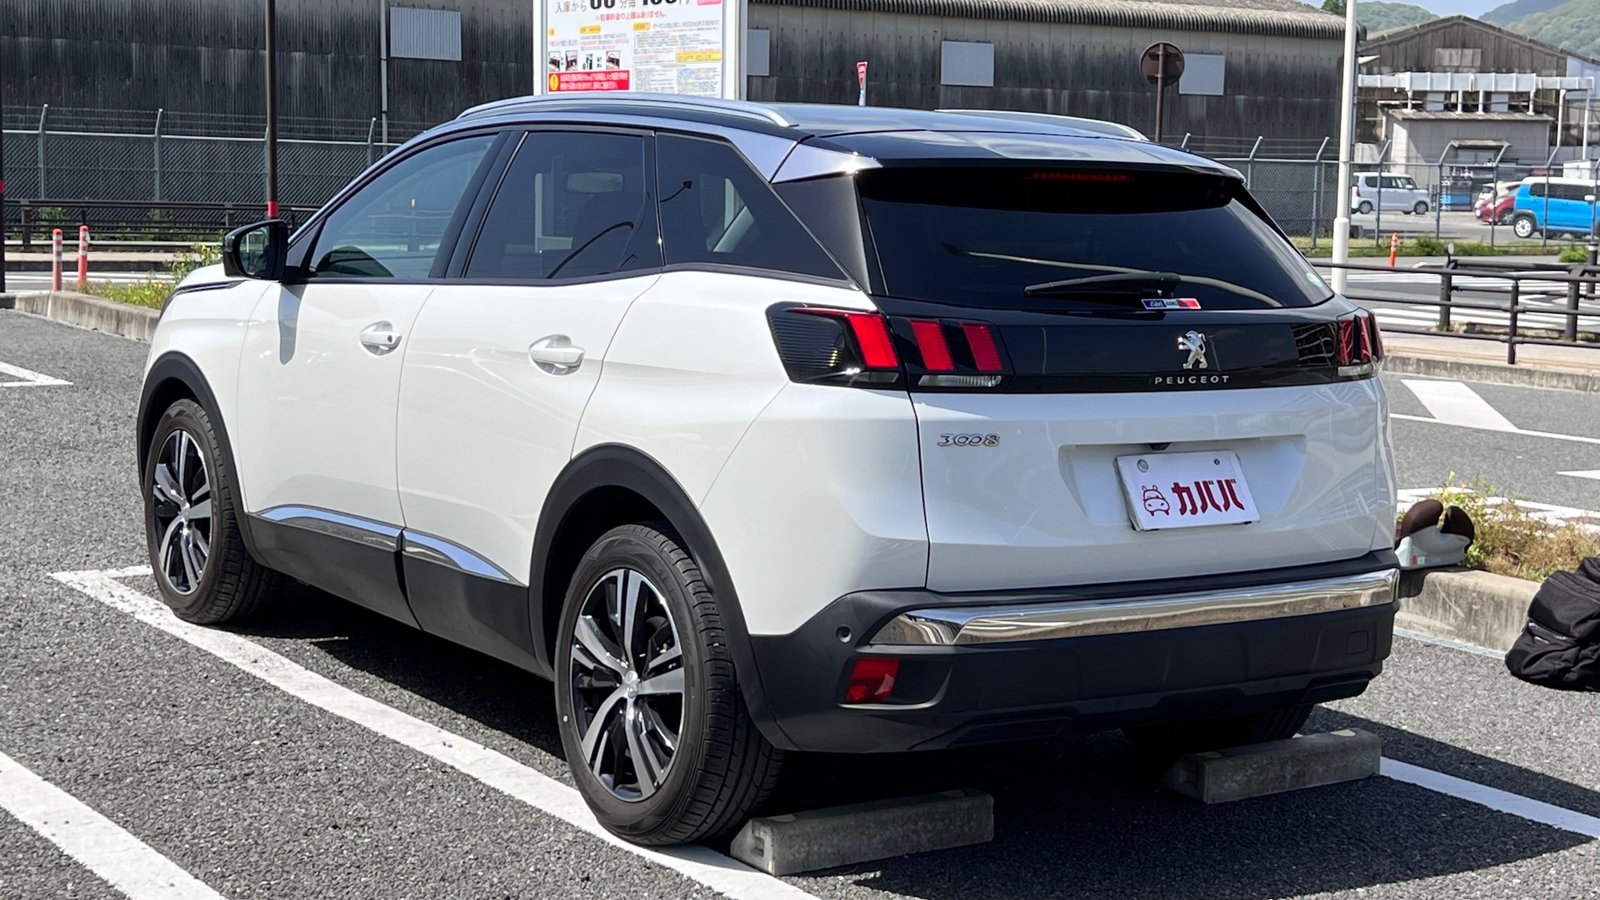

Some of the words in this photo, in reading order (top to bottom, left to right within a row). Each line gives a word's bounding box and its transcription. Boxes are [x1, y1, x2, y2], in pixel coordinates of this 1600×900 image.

[1154, 375, 1230, 385] PEUGEOT
[937, 433, 1000, 447] 3008
[1171, 478, 1246, 516] カババ
